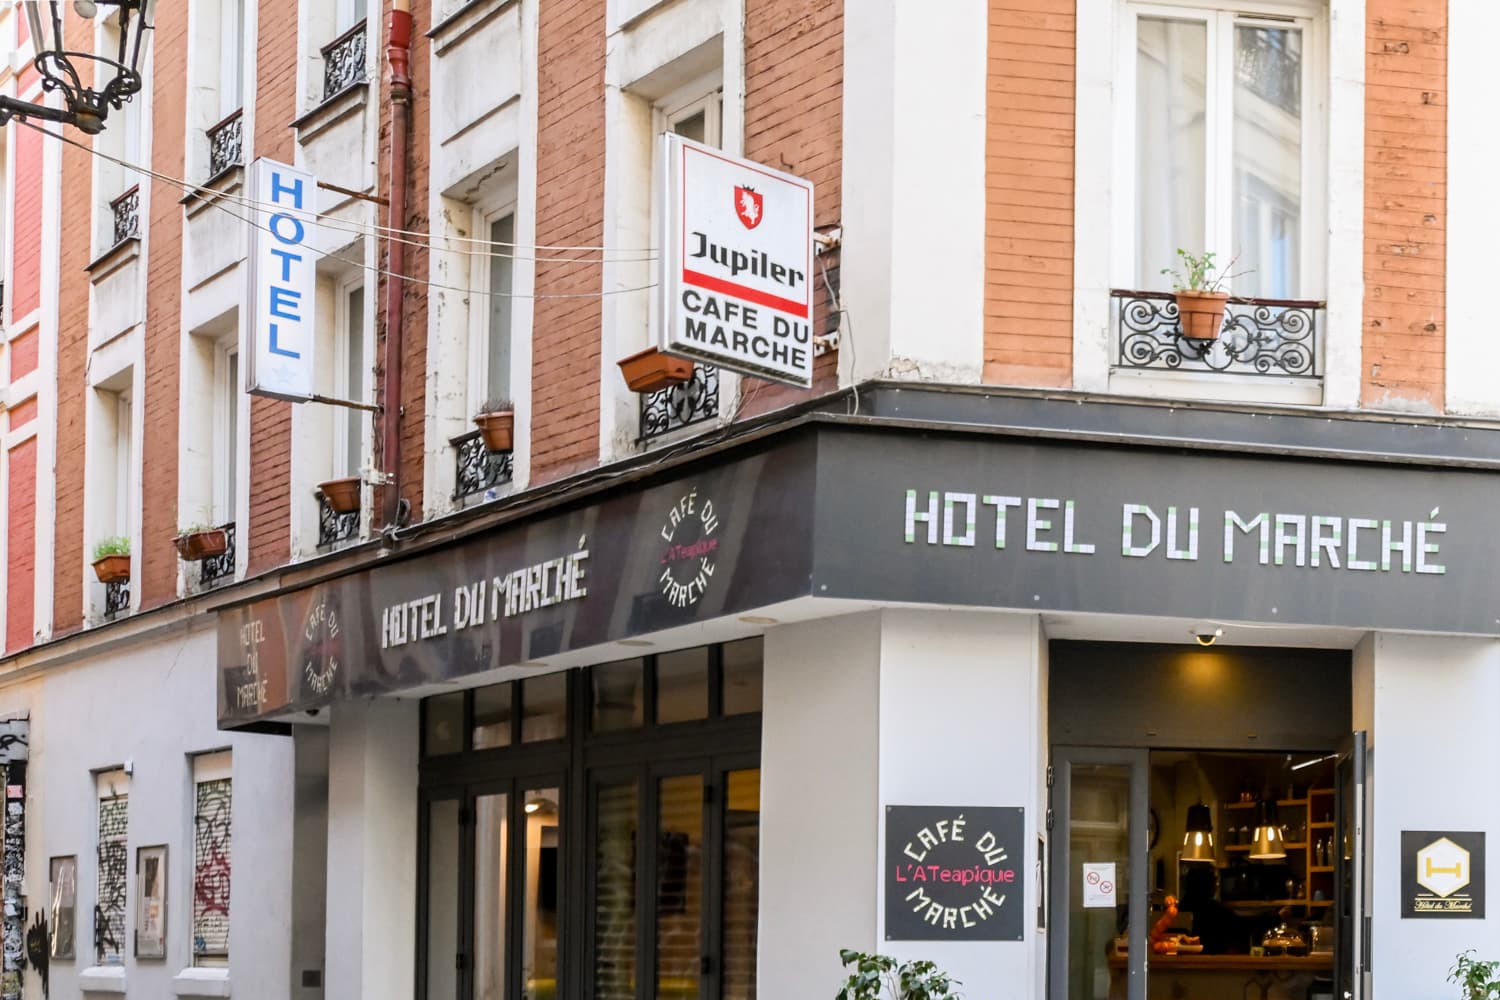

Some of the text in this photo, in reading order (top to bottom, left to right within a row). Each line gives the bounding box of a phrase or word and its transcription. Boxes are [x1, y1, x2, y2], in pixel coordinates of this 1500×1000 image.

[269, 171, 305, 360] HOTEL
[690, 231, 804, 288] Jupiler
[682, 289, 809, 344] CAFE DU
[685, 316, 806, 370] MARCHE
[661, 486, 719, 542] CAFÉ DU
[904, 489, 1447, 575] HOTEL DU MARCHÉ
[382, 533, 590, 649] HOTEL DU MARCHÉ
[660, 556, 716, 608] MARCHÉ
[240, 619, 266, 646] HOTEL
[327, 610, 339, 638] DU
[247, 650, 258, 675] DU
[904, 814, 1008, 866] CAFÉ DU
[896, 863, 1016, 887] L'ATeapique
[905, 885, 1006, 929] MARCHÉ
